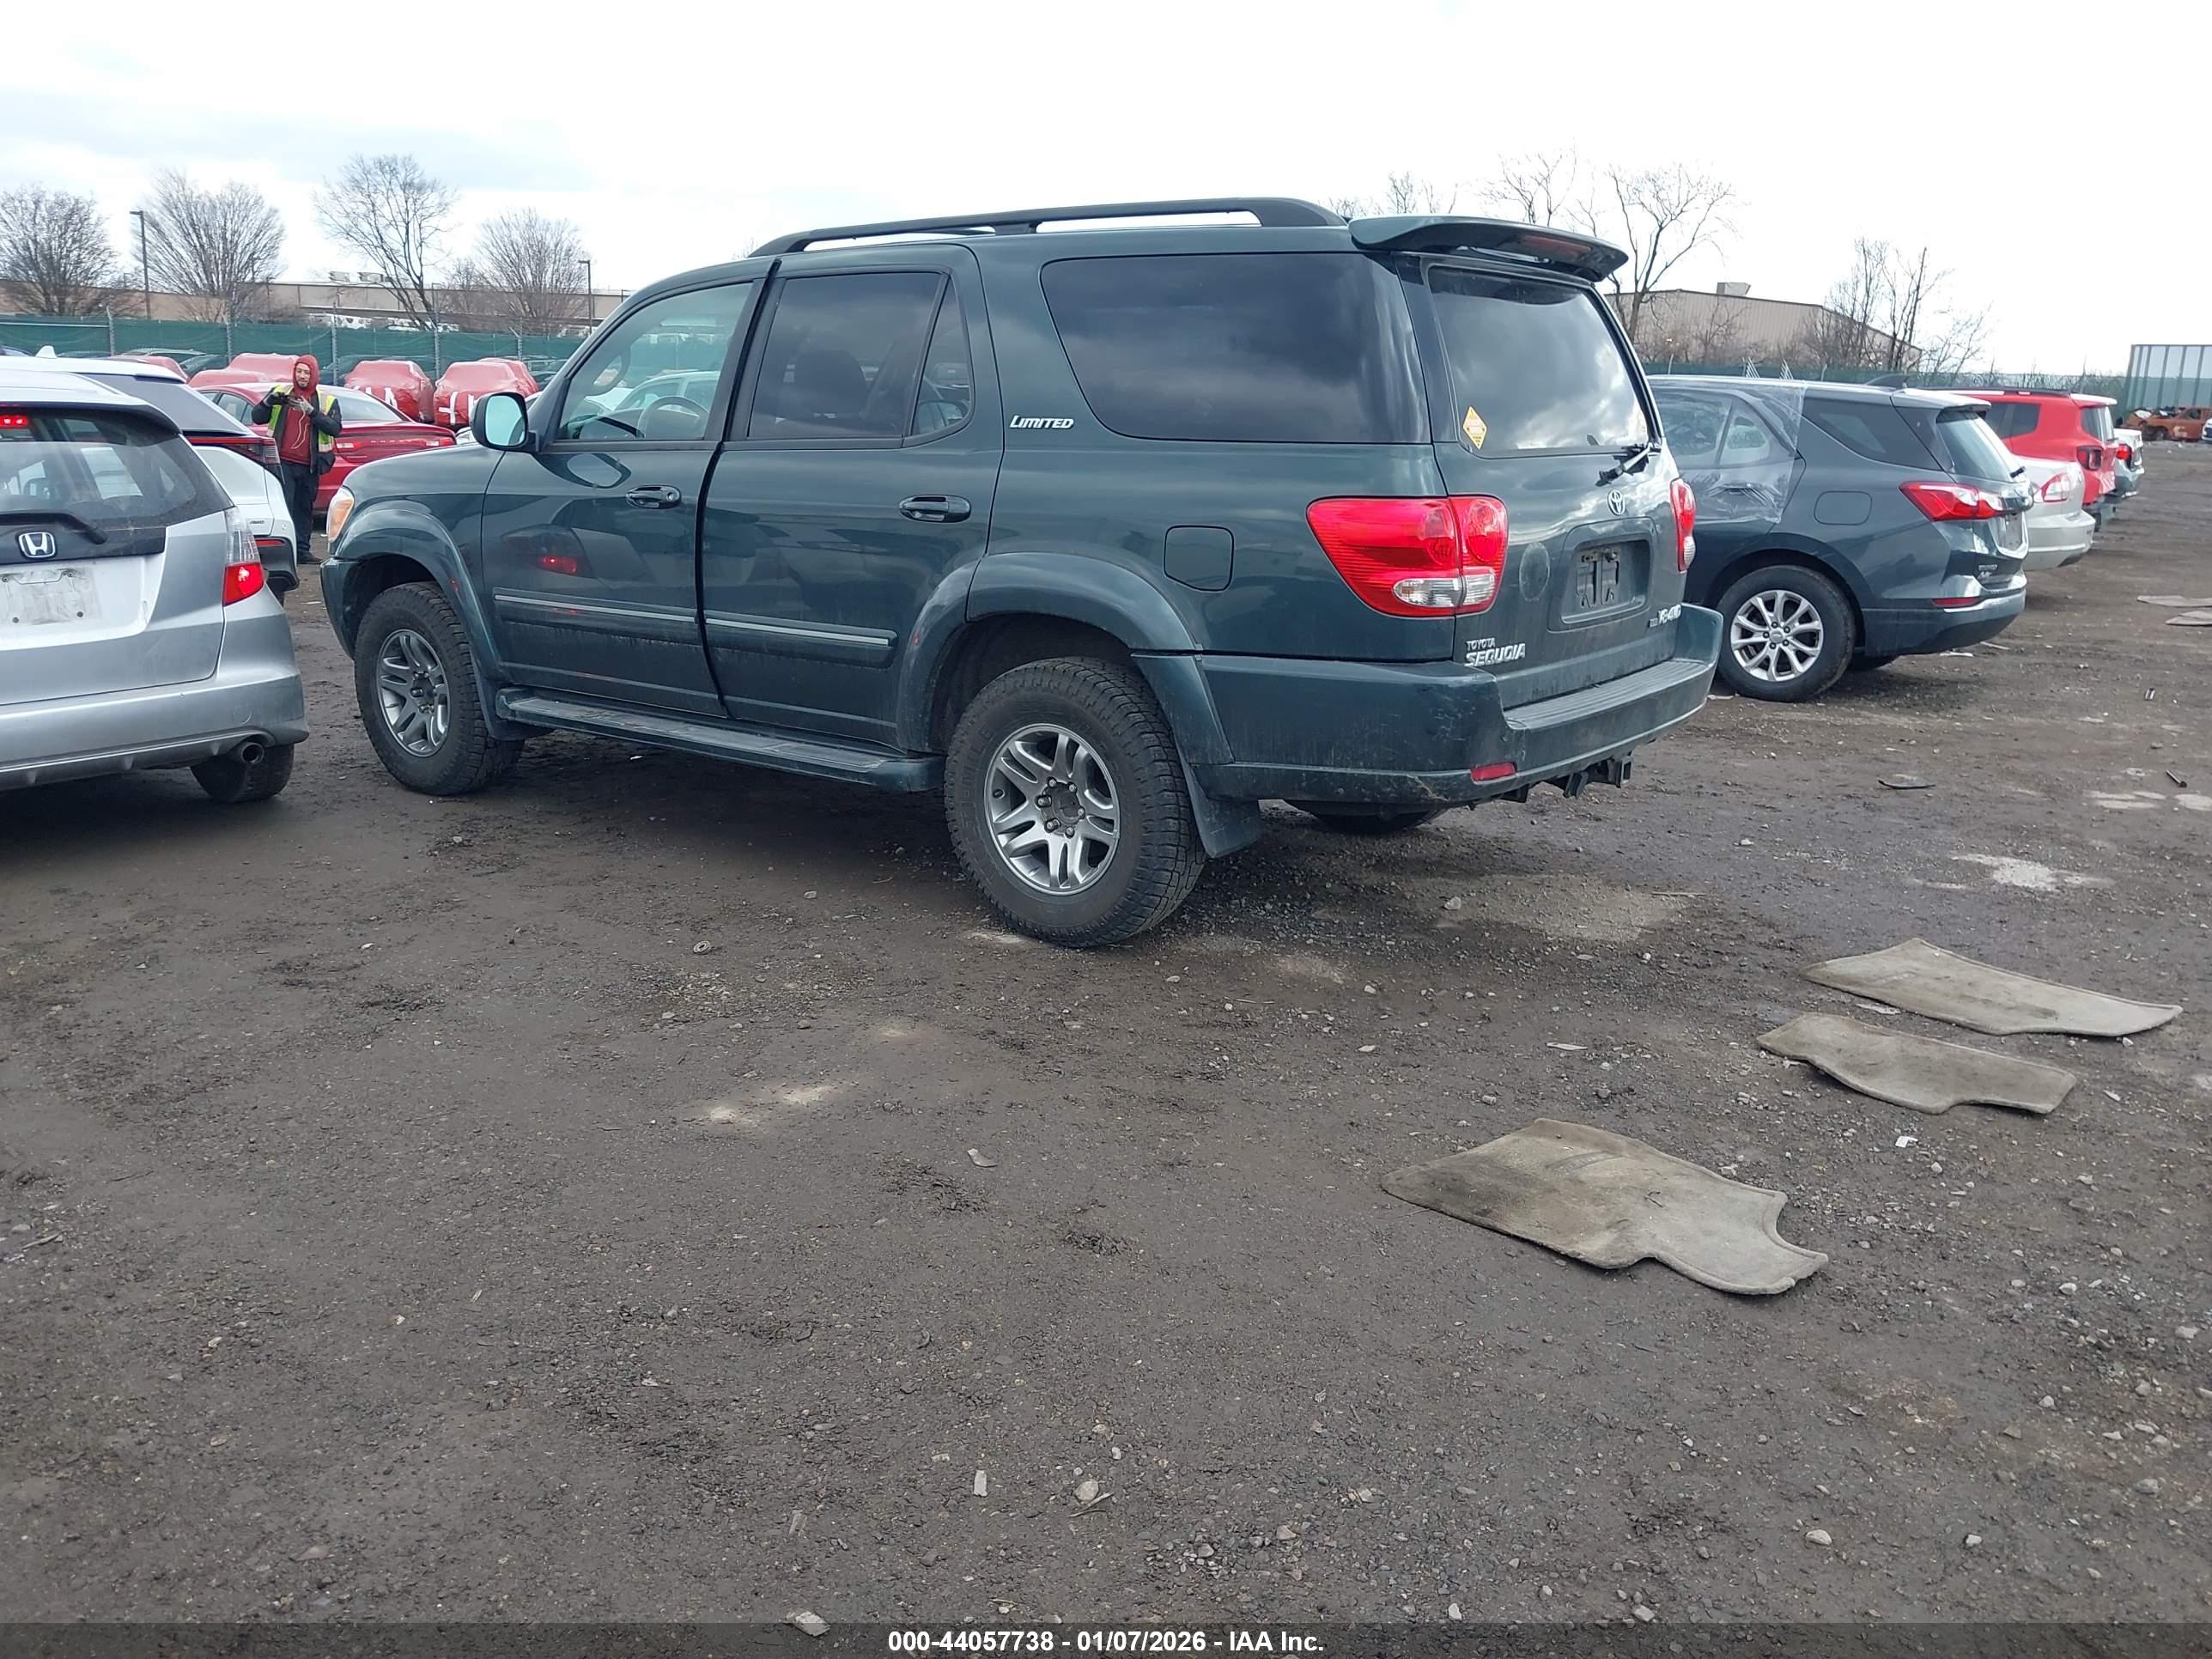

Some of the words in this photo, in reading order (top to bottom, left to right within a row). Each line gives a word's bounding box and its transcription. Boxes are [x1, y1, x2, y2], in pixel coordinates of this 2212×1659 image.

[1009, 415, 1074, 428] LIMITED
[1466, 637, 1496, 651] TOYOTA
[1464, 642, 1526, 666] SEQUOIA
